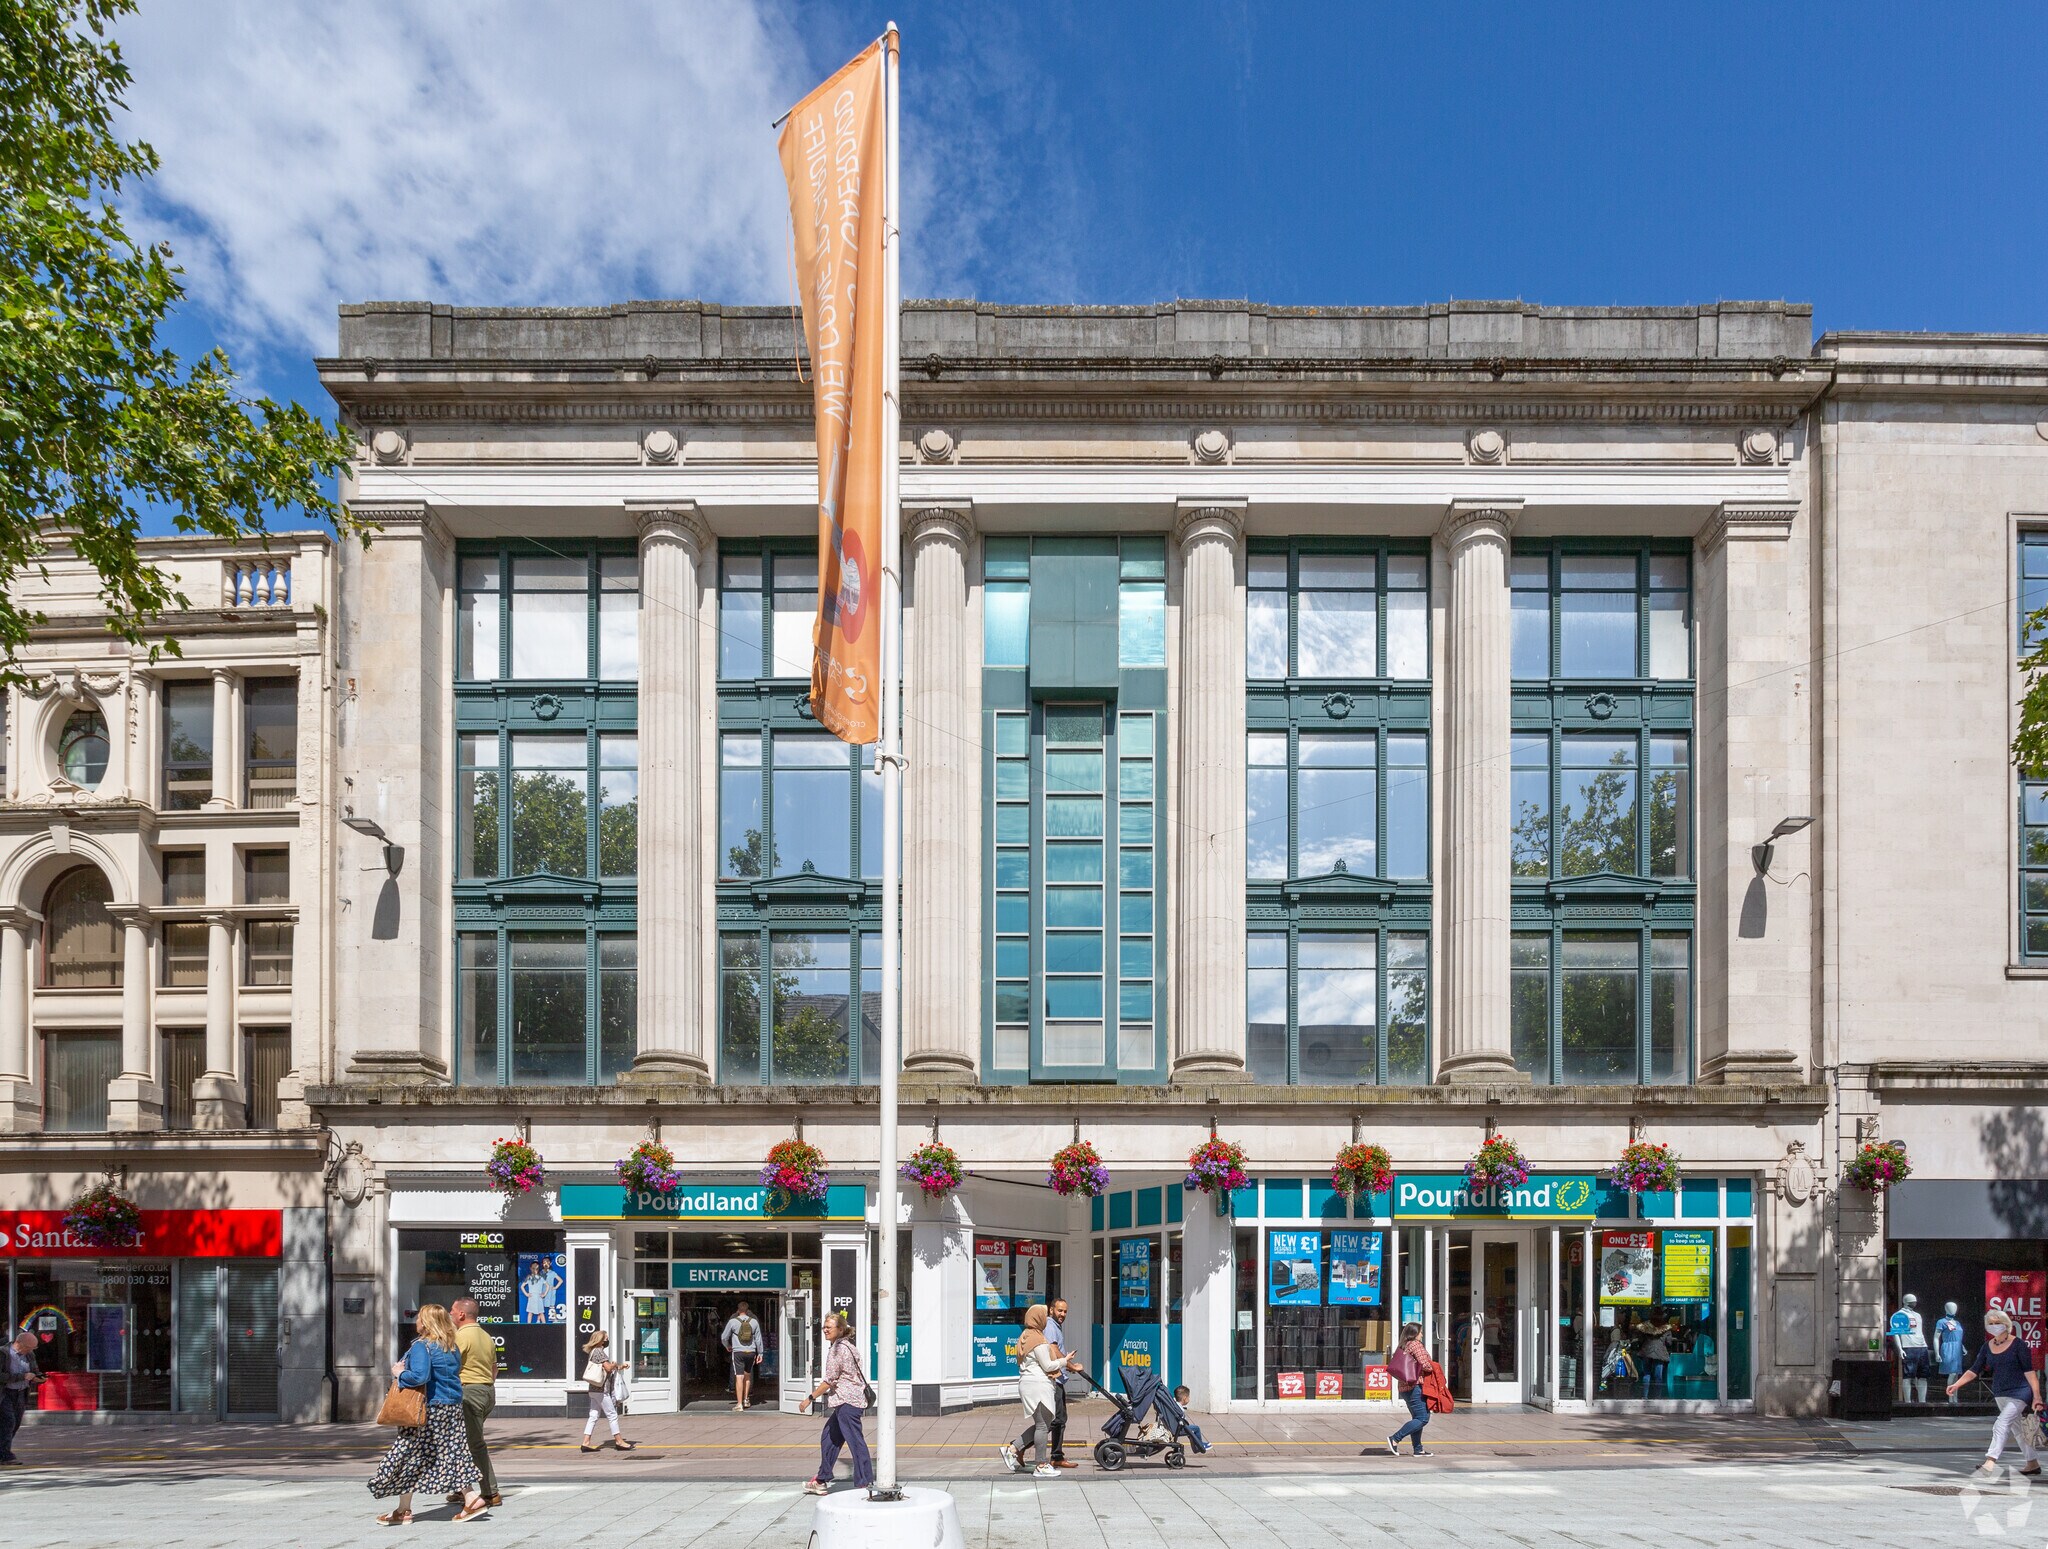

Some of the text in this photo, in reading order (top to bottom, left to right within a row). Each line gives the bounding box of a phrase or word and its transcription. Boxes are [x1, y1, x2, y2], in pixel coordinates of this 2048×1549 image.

[1274, 1234, 1317, 1250] NEW £1
[1334, 1235, 1380, 1250] NEW £2
[1629, 1233, 1648, 1247] £5
[994, 1242, 1006, 1254] £3
[1033, 1244, 1043, 1256] £1
[1136, 1245, 1147, 1258] £2
[476, 1264, 492, 1272] Get
[102, 1276, 169, 1285] 0800 030 4321
[689, 1269, 768, 1281] ENTRANCE
[578, 1296, 596, 1305] PEP
[834, 1297, 853, 1306] PEP
[1990, 1296, 2041, 1316] SALE
[548, 1304, 567, 1320] £3
[42, 1319, 54, 1327] NHS
[579, 1324, 595, 1333] CO
[1005, 1345, 1017, 1355] Val
[1123, 1339, 1148, 1351] Amazing
[982, 1347, 991, 1356] big
[1120, 1350, 1151, 1367] Value
[1368, 1372, 1388, 1388] £5
[1281, 1380, 1302, 1394] £2
[1319, 1380, 1340, 1395] £2
